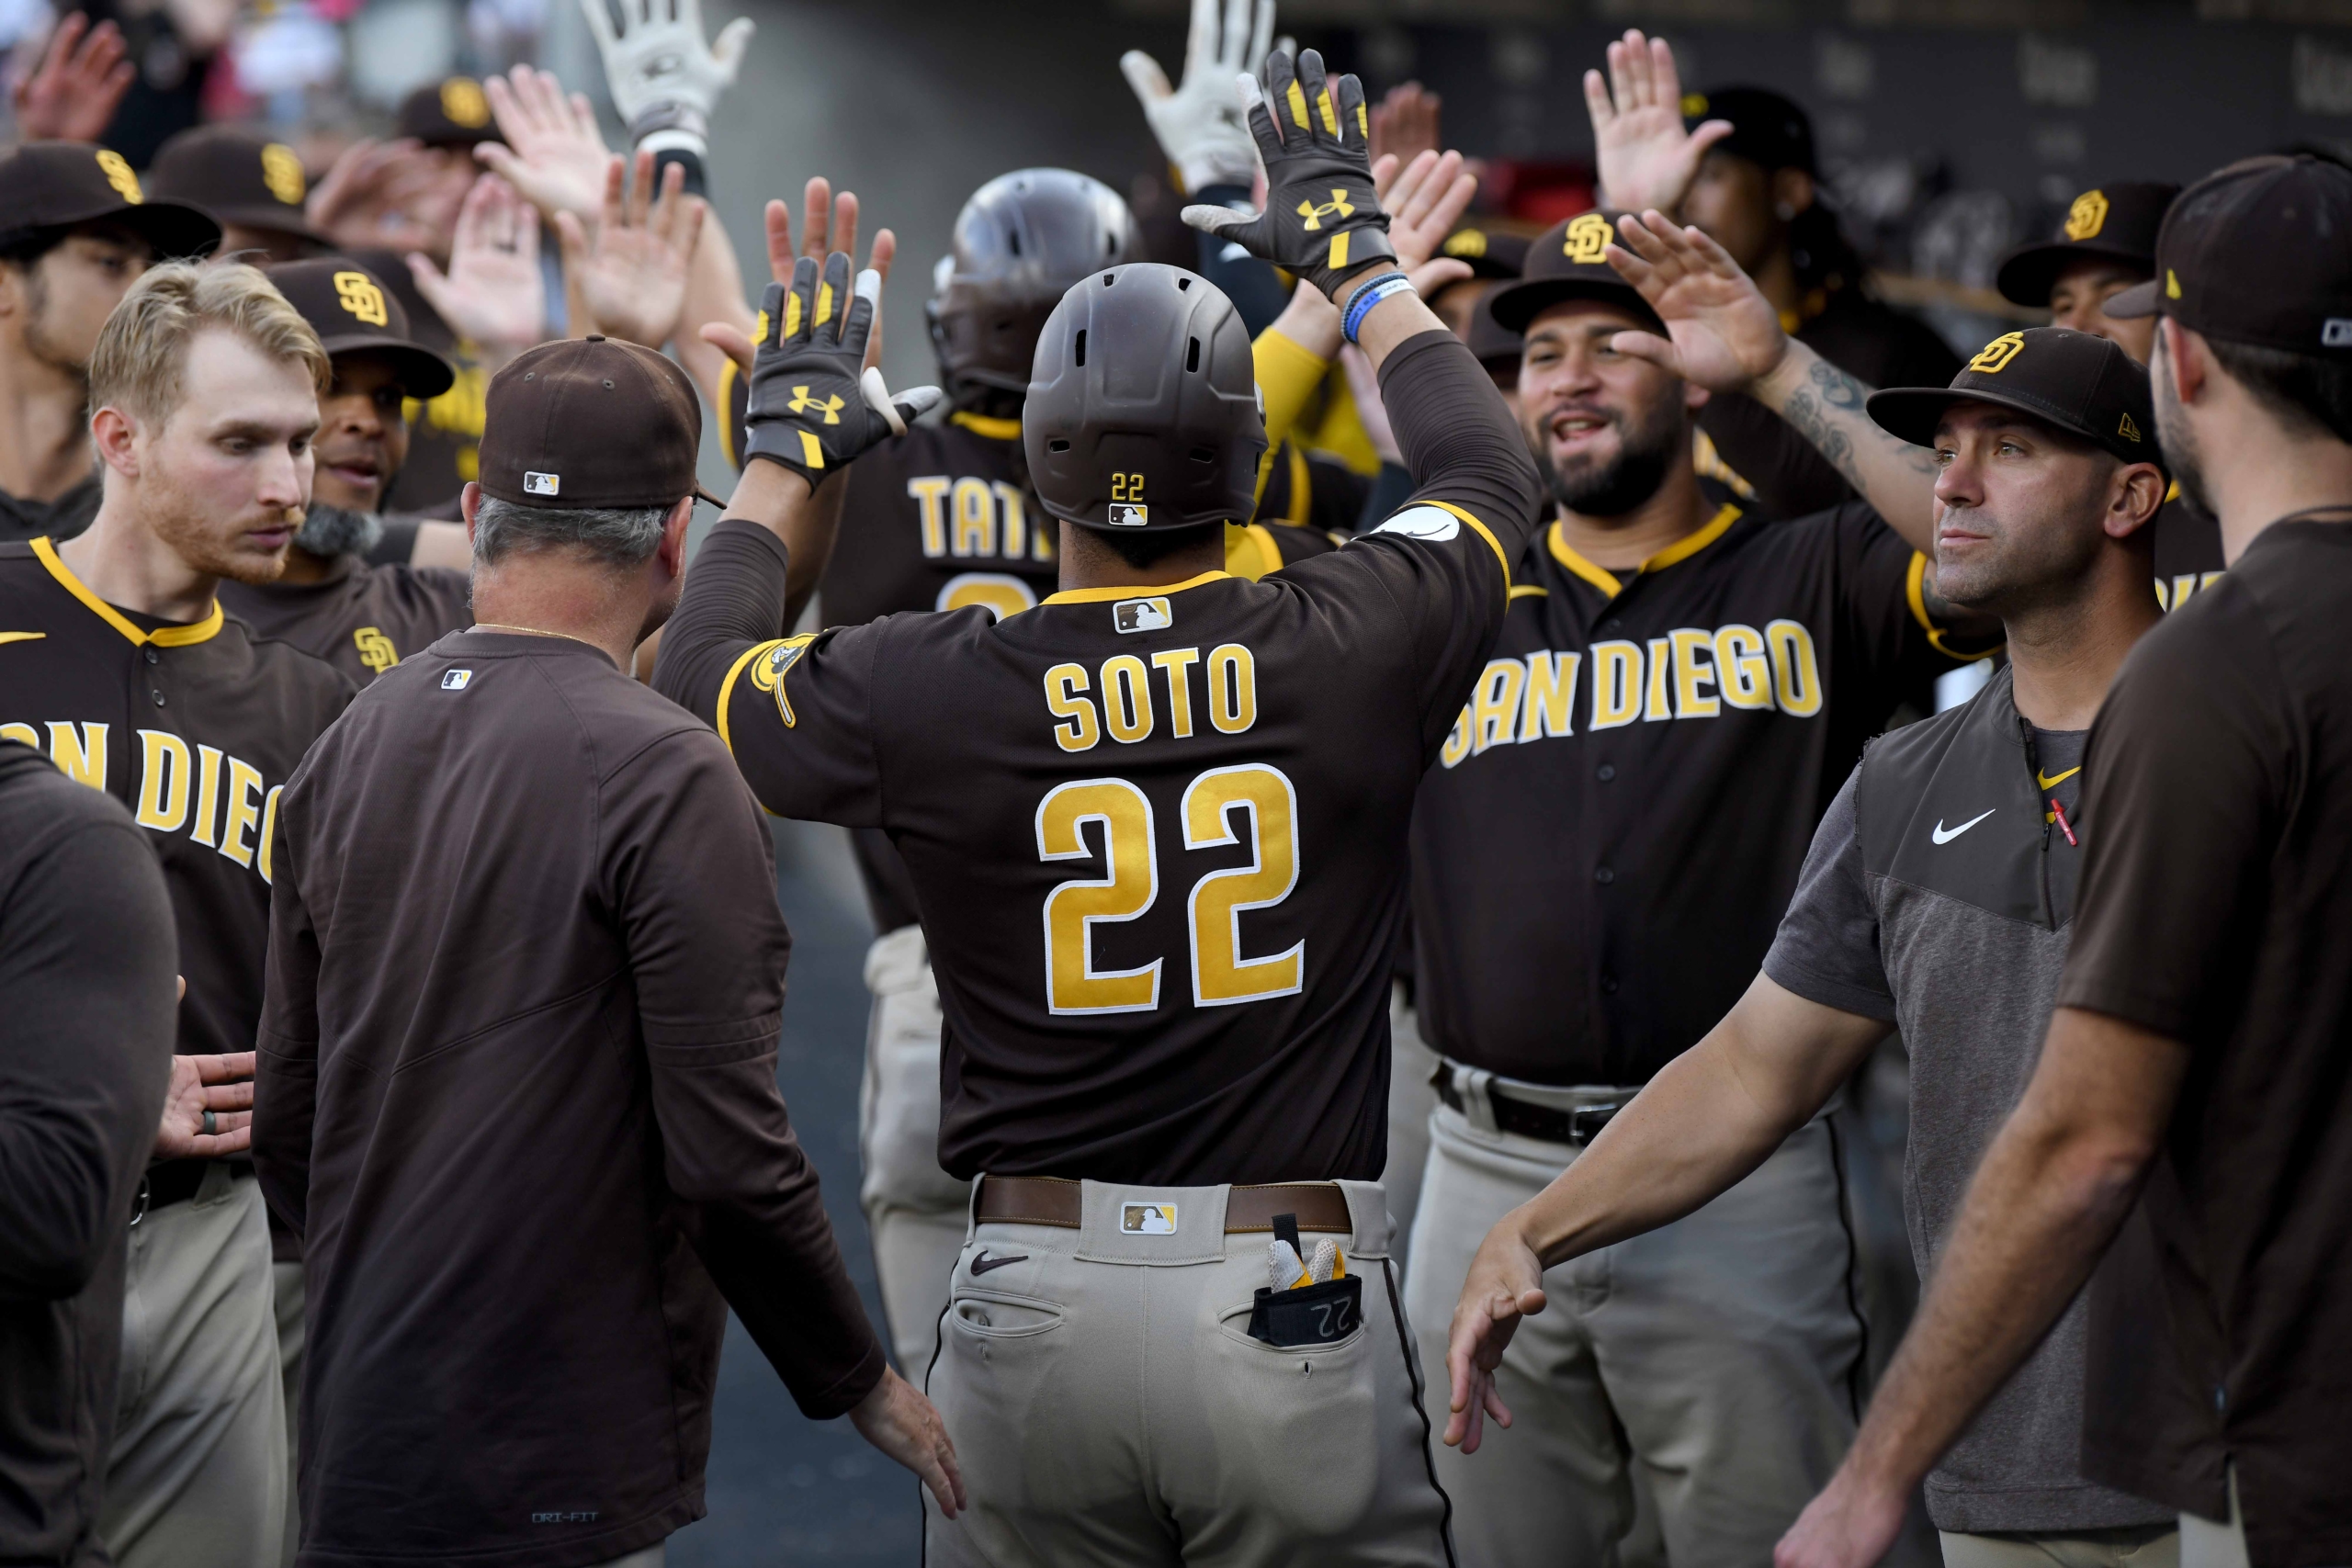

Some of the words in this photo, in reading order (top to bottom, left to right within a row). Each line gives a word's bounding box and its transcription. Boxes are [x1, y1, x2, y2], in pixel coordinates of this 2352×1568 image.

[1564, 213, 1614, 265] SD
[334, 271, 389, 328] SD
[1969, 331, 2026, 374] SD
[1112, 471, 1145, 502] 22
[353, 626, 400, 675] SD
[1589, 618, 1823, 731] DIEGO
[1044, 643, 1258, 753] SOTO
[1035, 762, 1306, 1016] 22
[1310, 1295, 1352, 1337] 22
[532, 1512, 599, 1524] DRI-FIT
